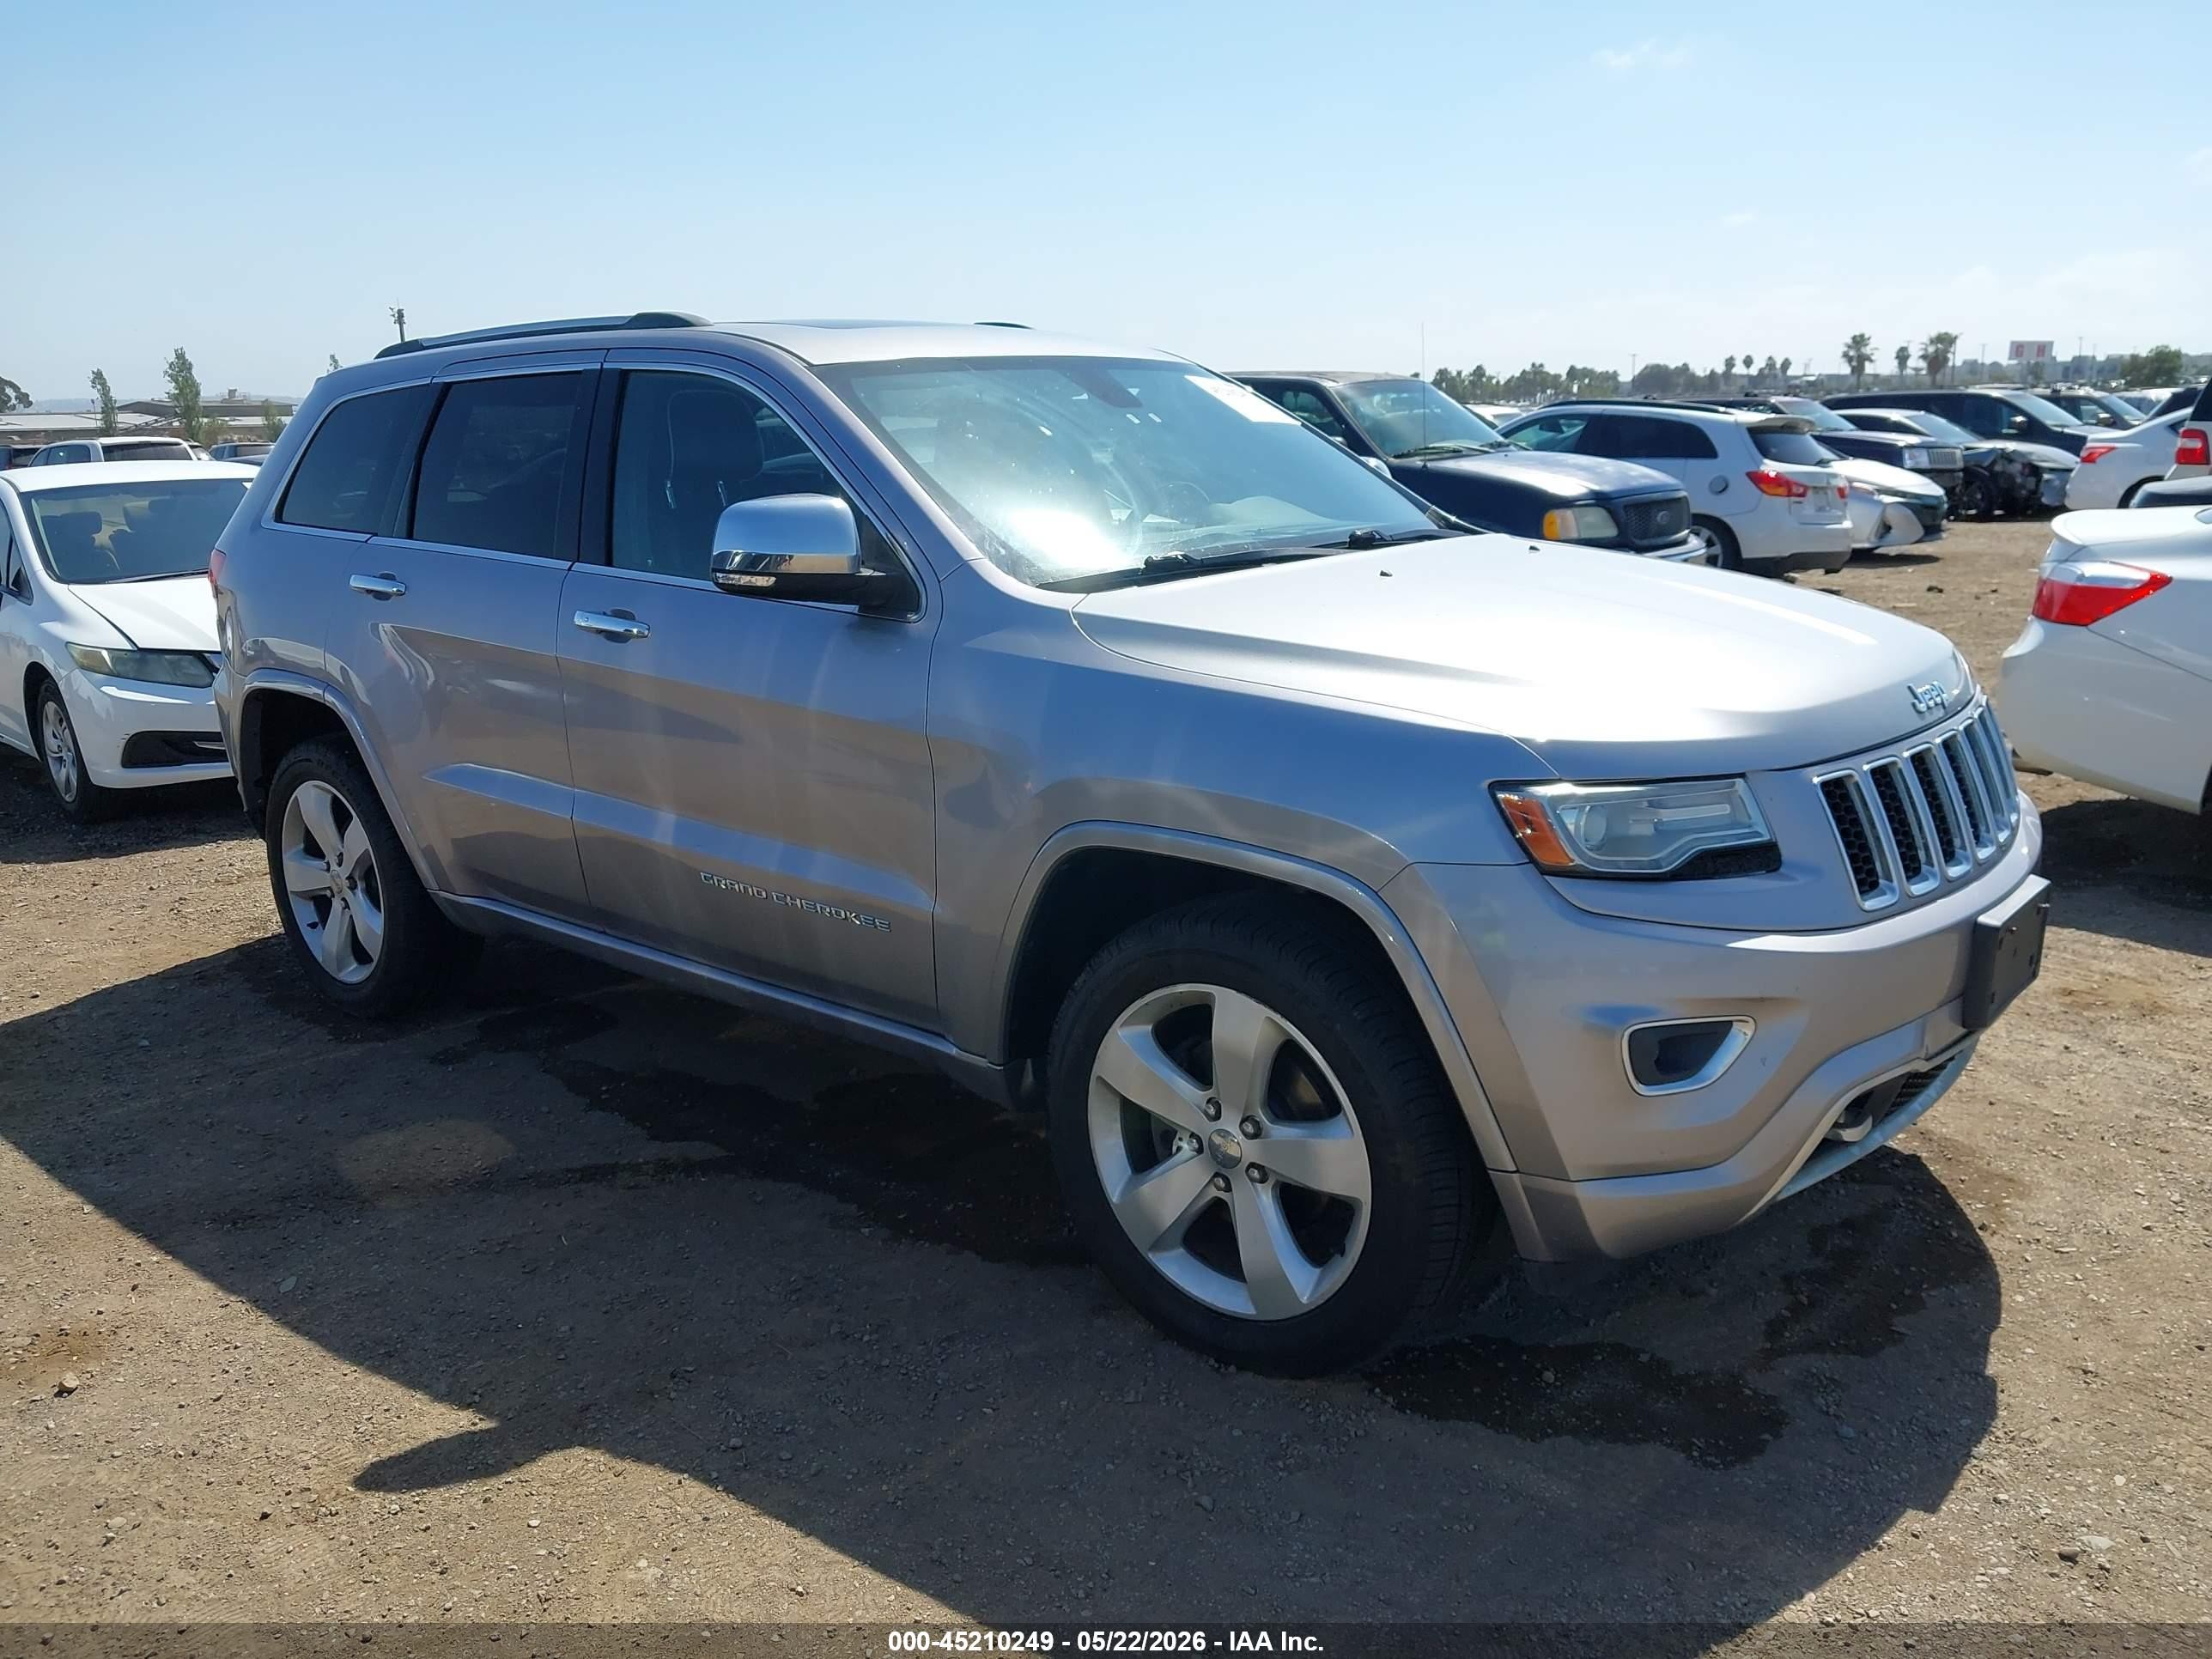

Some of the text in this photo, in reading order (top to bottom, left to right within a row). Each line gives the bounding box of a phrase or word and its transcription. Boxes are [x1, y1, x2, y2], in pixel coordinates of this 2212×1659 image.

[1906, 681, 1948, 713] Jeep
[700, 872, 892, 933] GRAND CHEROKEE
